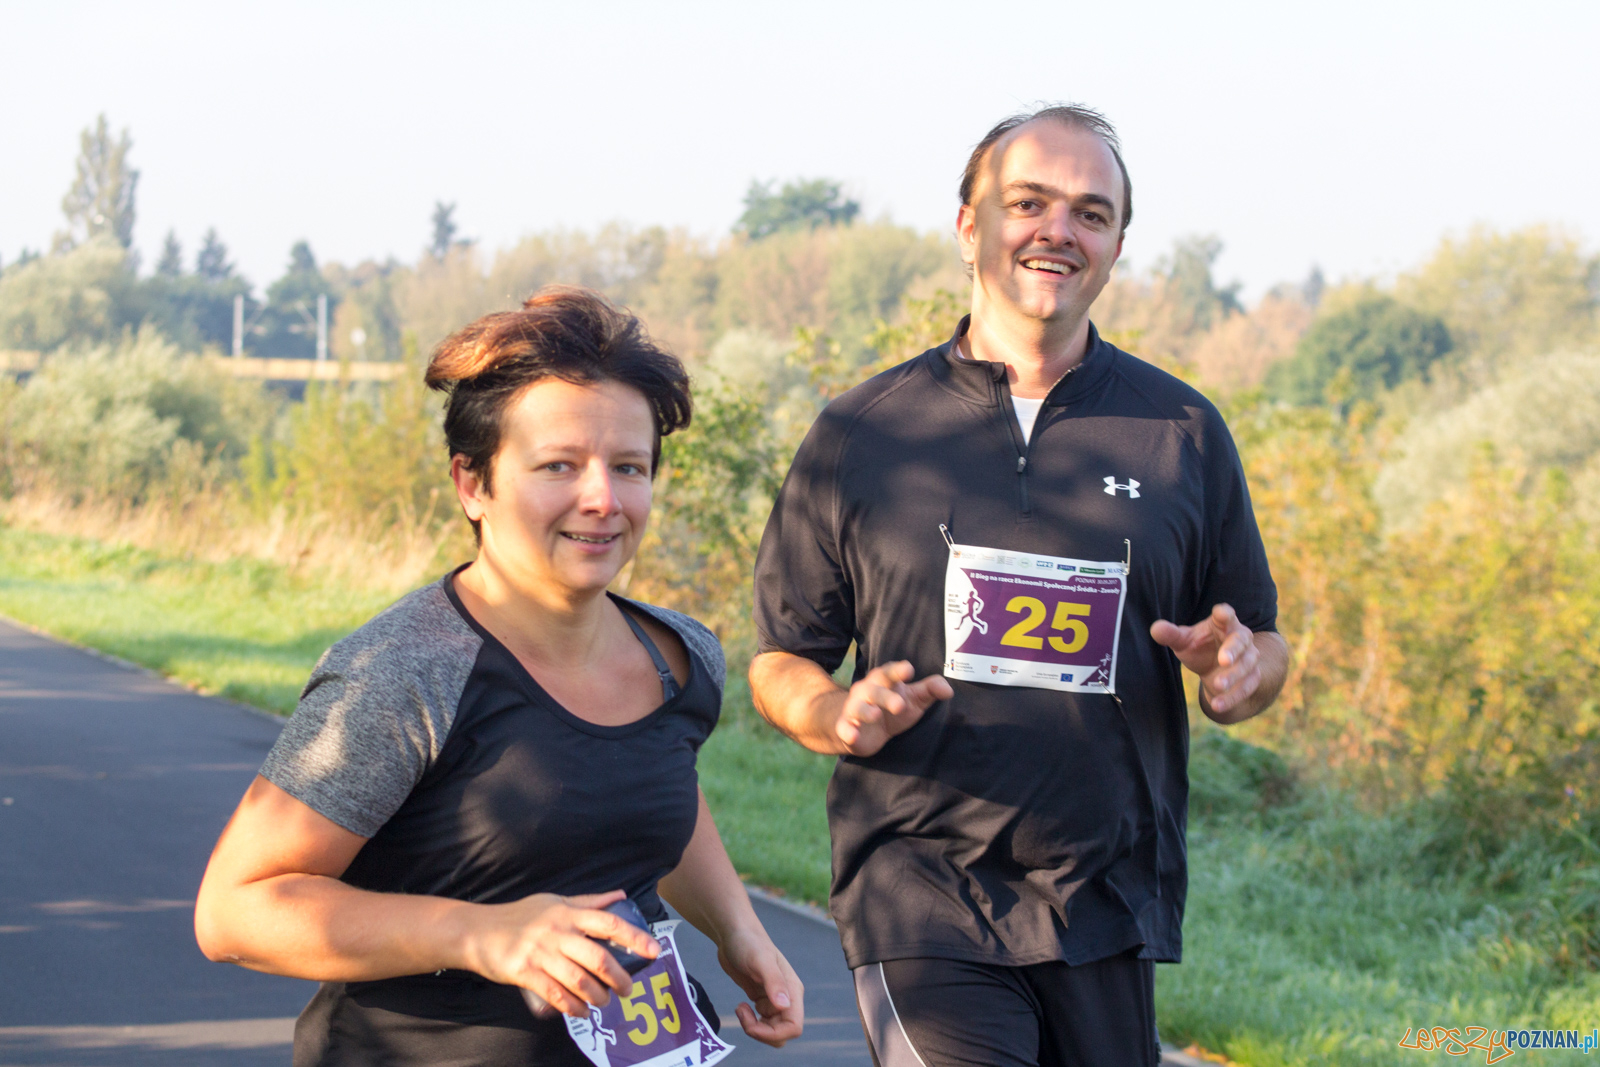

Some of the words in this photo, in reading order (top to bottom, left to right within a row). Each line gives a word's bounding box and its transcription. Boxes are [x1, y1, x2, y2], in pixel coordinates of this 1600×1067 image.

[975, 572, 989, 581] Bieg
[1014, 577, 1043, 587] Ekonomii
[1043, 581, 1076, 592] Społecznej
[1000, 595, 1092, 654] 25
[618, 971, 681, 1046] 55
